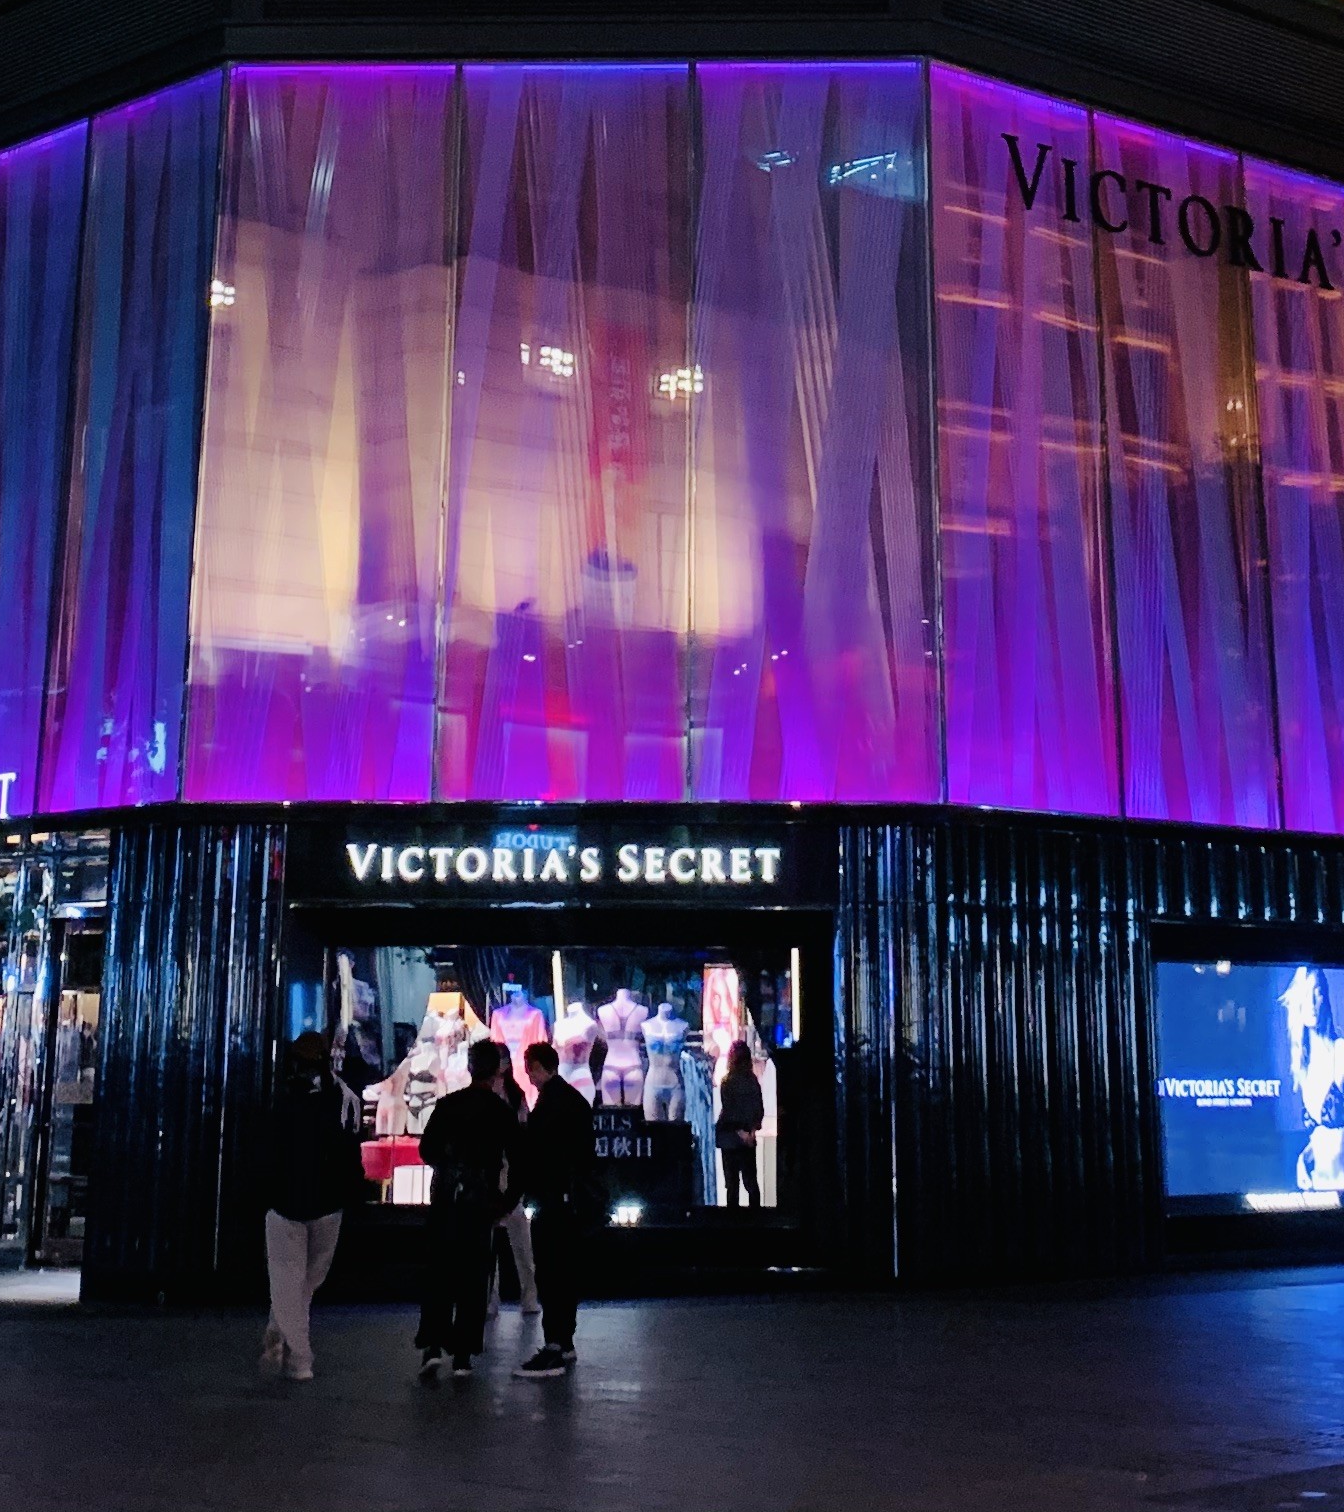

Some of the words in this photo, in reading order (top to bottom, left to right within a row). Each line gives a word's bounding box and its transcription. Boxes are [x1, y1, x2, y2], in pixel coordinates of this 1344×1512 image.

[346, 843, 601, 883] VICTORIA'S
[618, 844, 781, 883] SECRET
[1165, 1078, 1235, 1097] VICTORIA'S
[1237, 1078, 1281, 1097] SECRET
